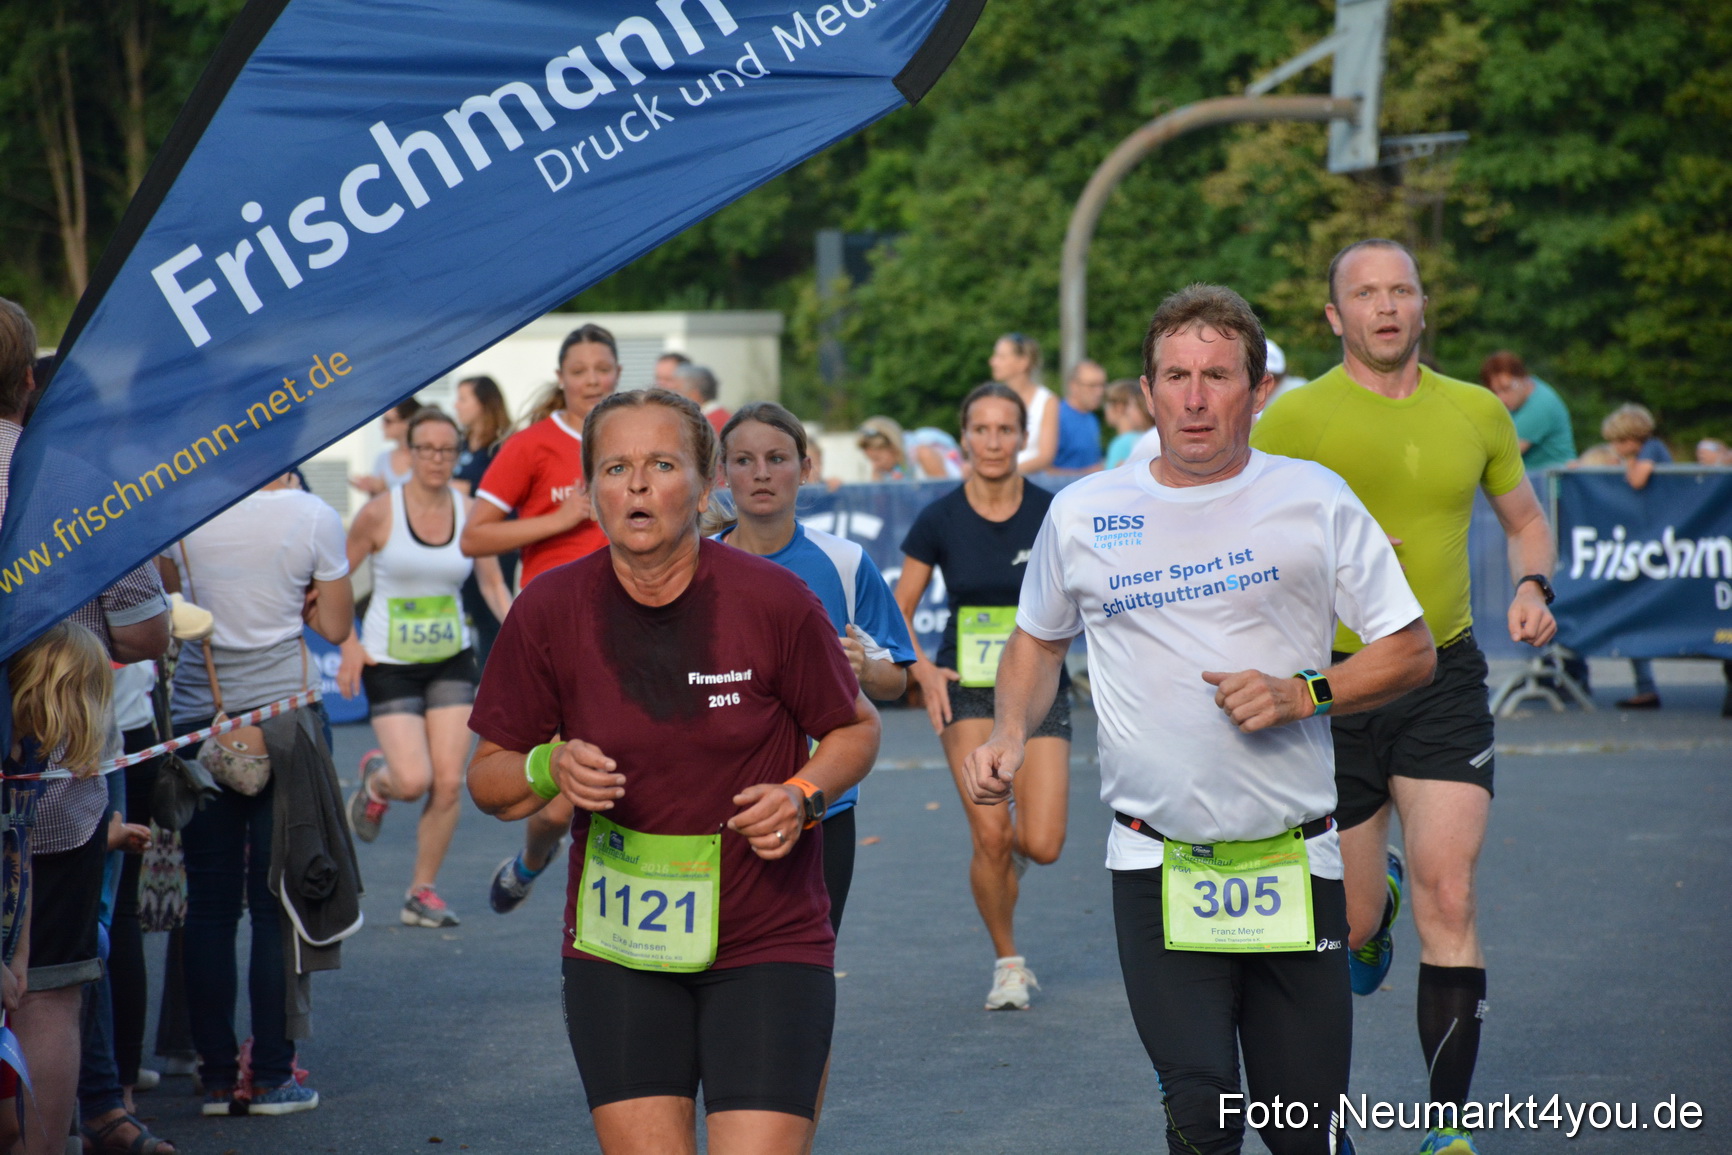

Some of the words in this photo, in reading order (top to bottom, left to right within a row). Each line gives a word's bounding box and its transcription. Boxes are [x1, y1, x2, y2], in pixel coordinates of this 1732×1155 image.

[533, 93, 675, 193] Druck
[679, 41, 771, 106] und
[150, 0, 738, 347] Frischmann
[1093, 515, 1145, 533] DESS
[1093, 538, 1143, 549] Logistik
[1095, 531, 1143, 542] Transporte
[1109, 569, 1163, 590] Unser
[1169, 556, 1223, 580] Sport
[1228, 548, 1254, 567] ist
[1102, 566, 1280, 618] SchüttguttranSport
[397, 623, 455, 645] 1554
[708, 692, 741, 708] 2016
[592, 876, 696, 934] 1121
[1192, 875, 1282, 919] 305
[612, 933, 628, 946] Elke
[628, 937, 667, 952] Janssen
[1211, 927, 1237, 936] Franz
[1238, 927, 1265, 937] Meyer
